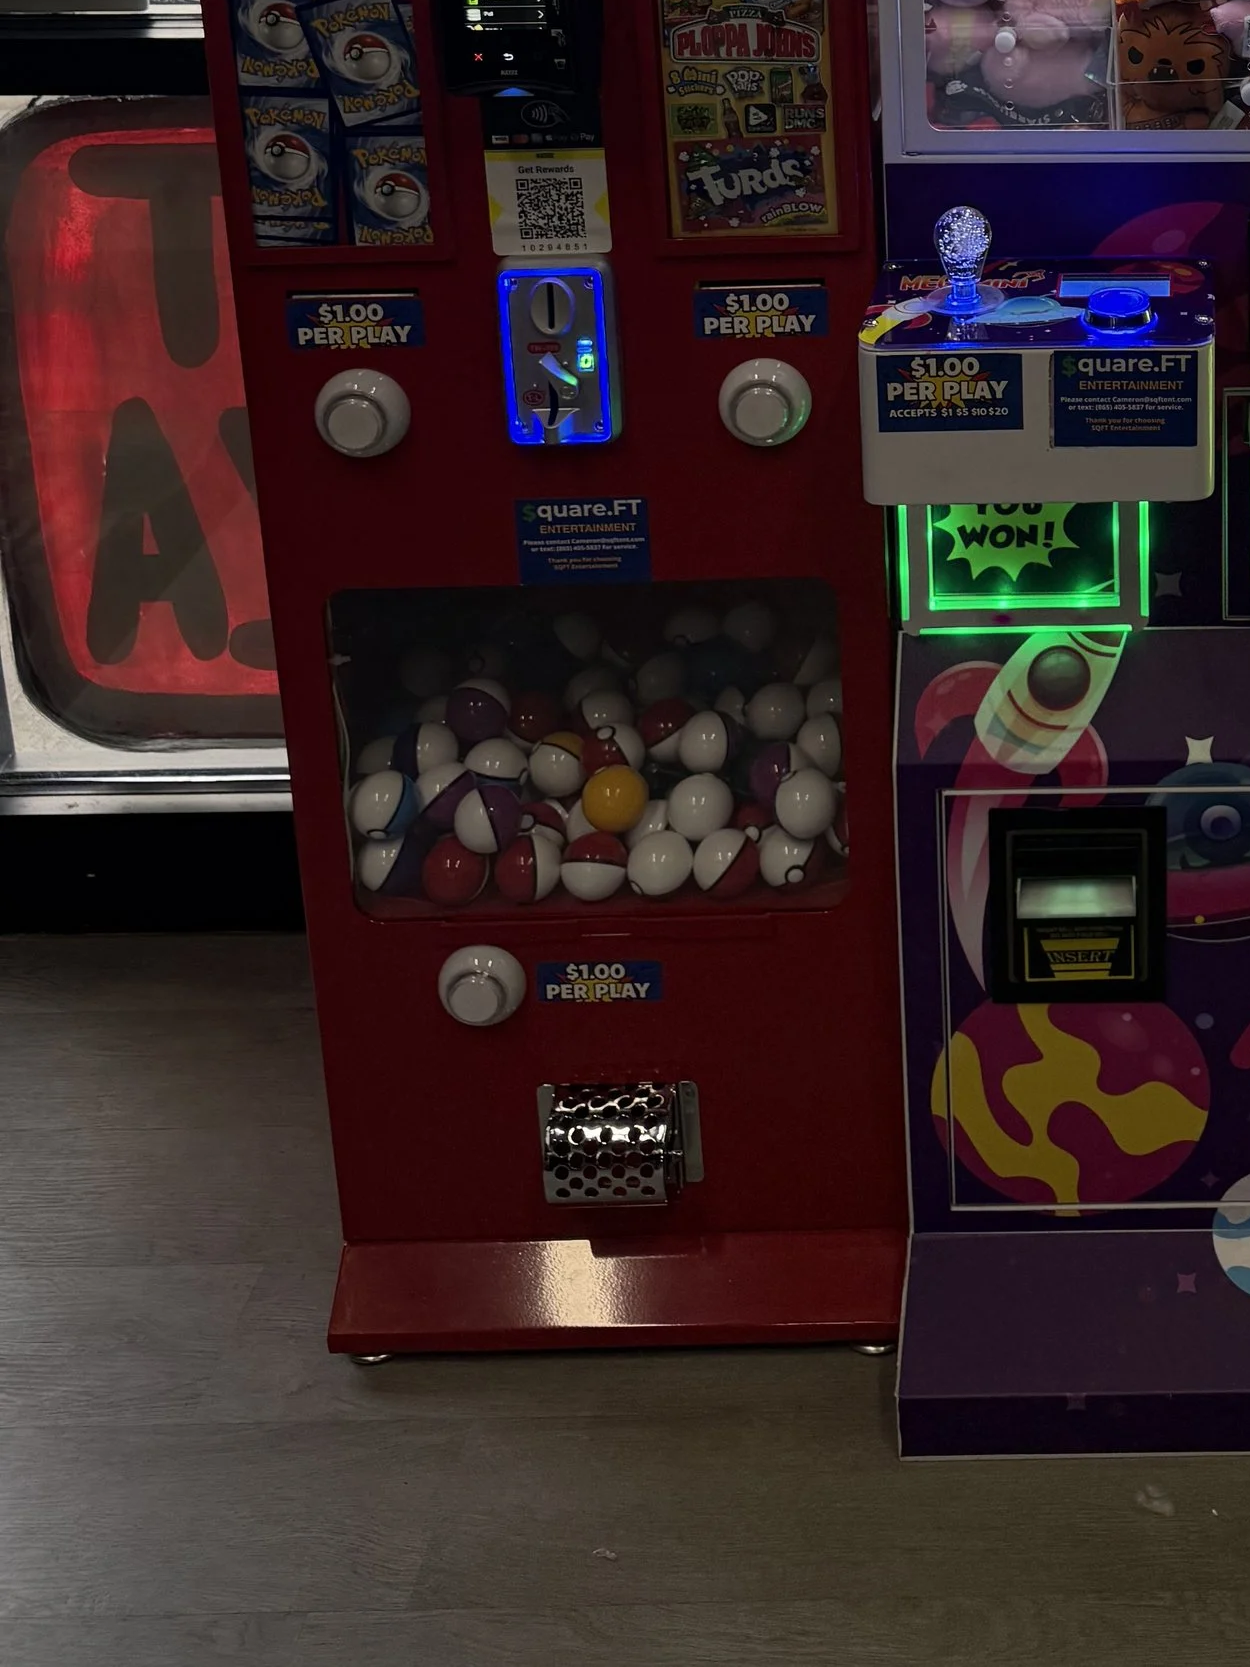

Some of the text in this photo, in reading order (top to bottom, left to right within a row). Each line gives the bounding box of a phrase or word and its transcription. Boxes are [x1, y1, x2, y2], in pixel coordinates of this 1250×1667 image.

[728, 8, 762, 19] PIZZA
[677, 23, 751, 58] PLOPPA
[518, 165, 575, 175] Get Rewards
[725, 292, 790, 313] $1.00
[317, 303, 384, 324] $1.00
[703, 313, 817, 335] PER PLAY
[297, 325, 411, 346] PER PLAY
[910, 356, 980, 378] $1.00
[1061, 354, 1192, 377] $quare.FT
[886, 380, 1009, 402] PER PLAY
[1079, 379, 1185, 391] ENTERTAINMENT
[1060, 396, 1084, 404] Please
[889, 406, 1009, 418] ACCEPTS $1 $5 $10 $20
[539, 522, 637, 534] ENTERTAINMENT
[957, 521, 1055, 550] WON!
[1046, 950, 1116, 963] INSERT
[565, 963, 626, 981] $1.00
[545, 982, 652, 1000] PER PLAY
